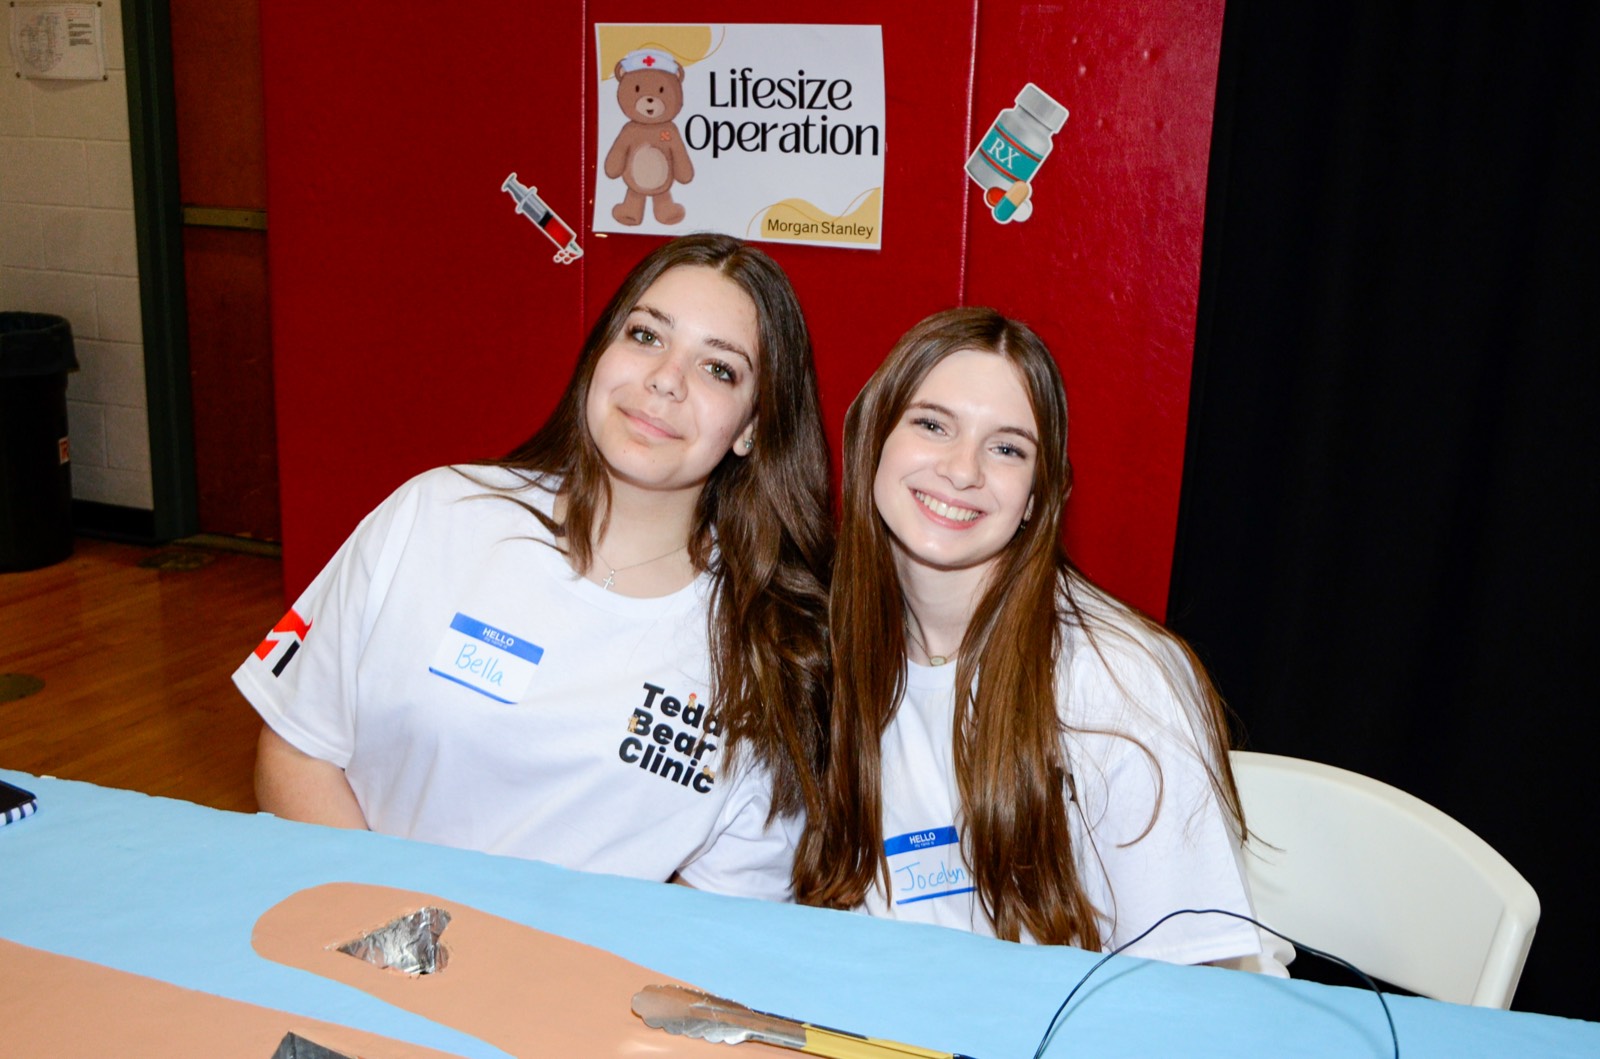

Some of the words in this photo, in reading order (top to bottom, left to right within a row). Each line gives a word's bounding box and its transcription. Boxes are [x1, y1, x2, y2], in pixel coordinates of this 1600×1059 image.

[709, 67, 852, 111] Lifesize
[684, 114, 879, 159] Operation
[988, 137, 1020, 170] RX
[767, 218, 819, 235] Morgan
[821, 221, 874, 239] Stanley
[482, 627, 515, 647] HELLO
[455, 643, 503, 687] Bella
[642, 682, 721, 738] Tedd
[630, 707, 717, 761] Bear
[618, 736, 715, 794] Clinic
[909, 831, 936, 845] HELLO
[894, 861, 966, 892] Jocelyn
